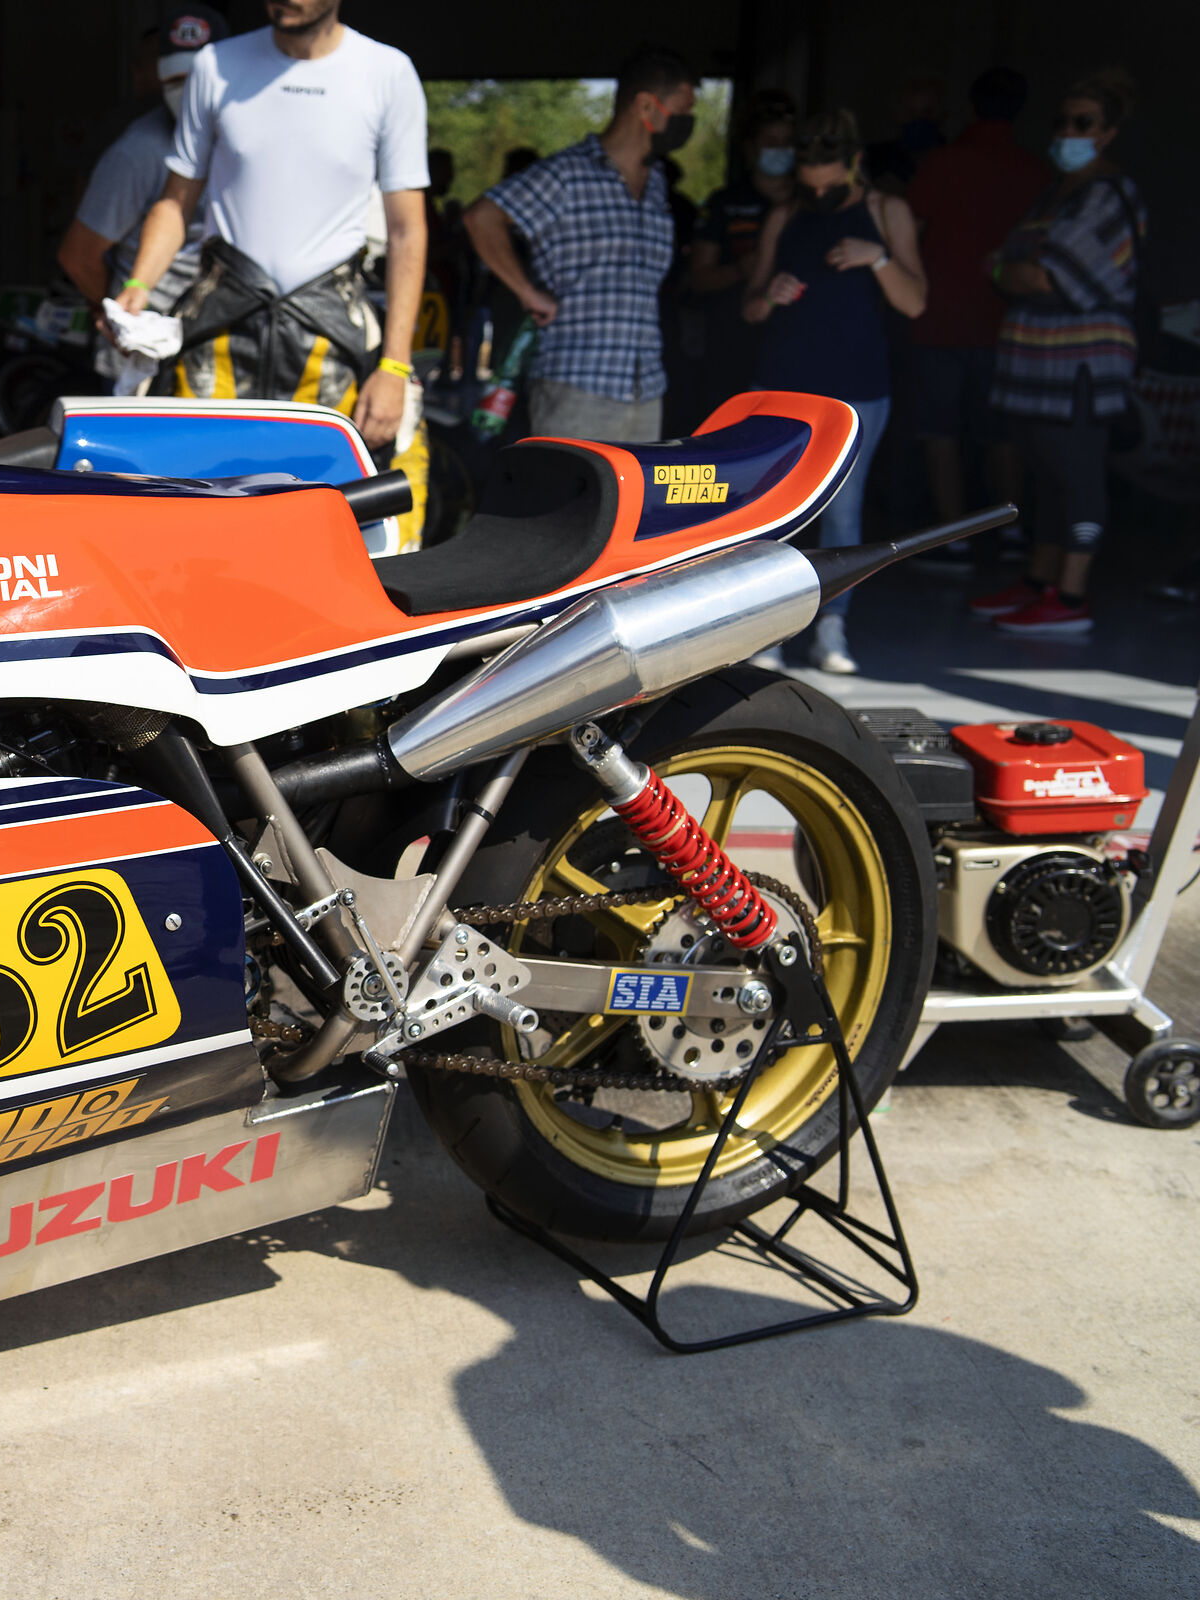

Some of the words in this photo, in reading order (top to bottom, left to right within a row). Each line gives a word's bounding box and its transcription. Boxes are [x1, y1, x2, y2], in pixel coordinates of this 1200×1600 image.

[658, 468, 712, 481] OLIO
[670, 487, 724, 500] FIAT
[613, 976, 681, 1010] SIA
